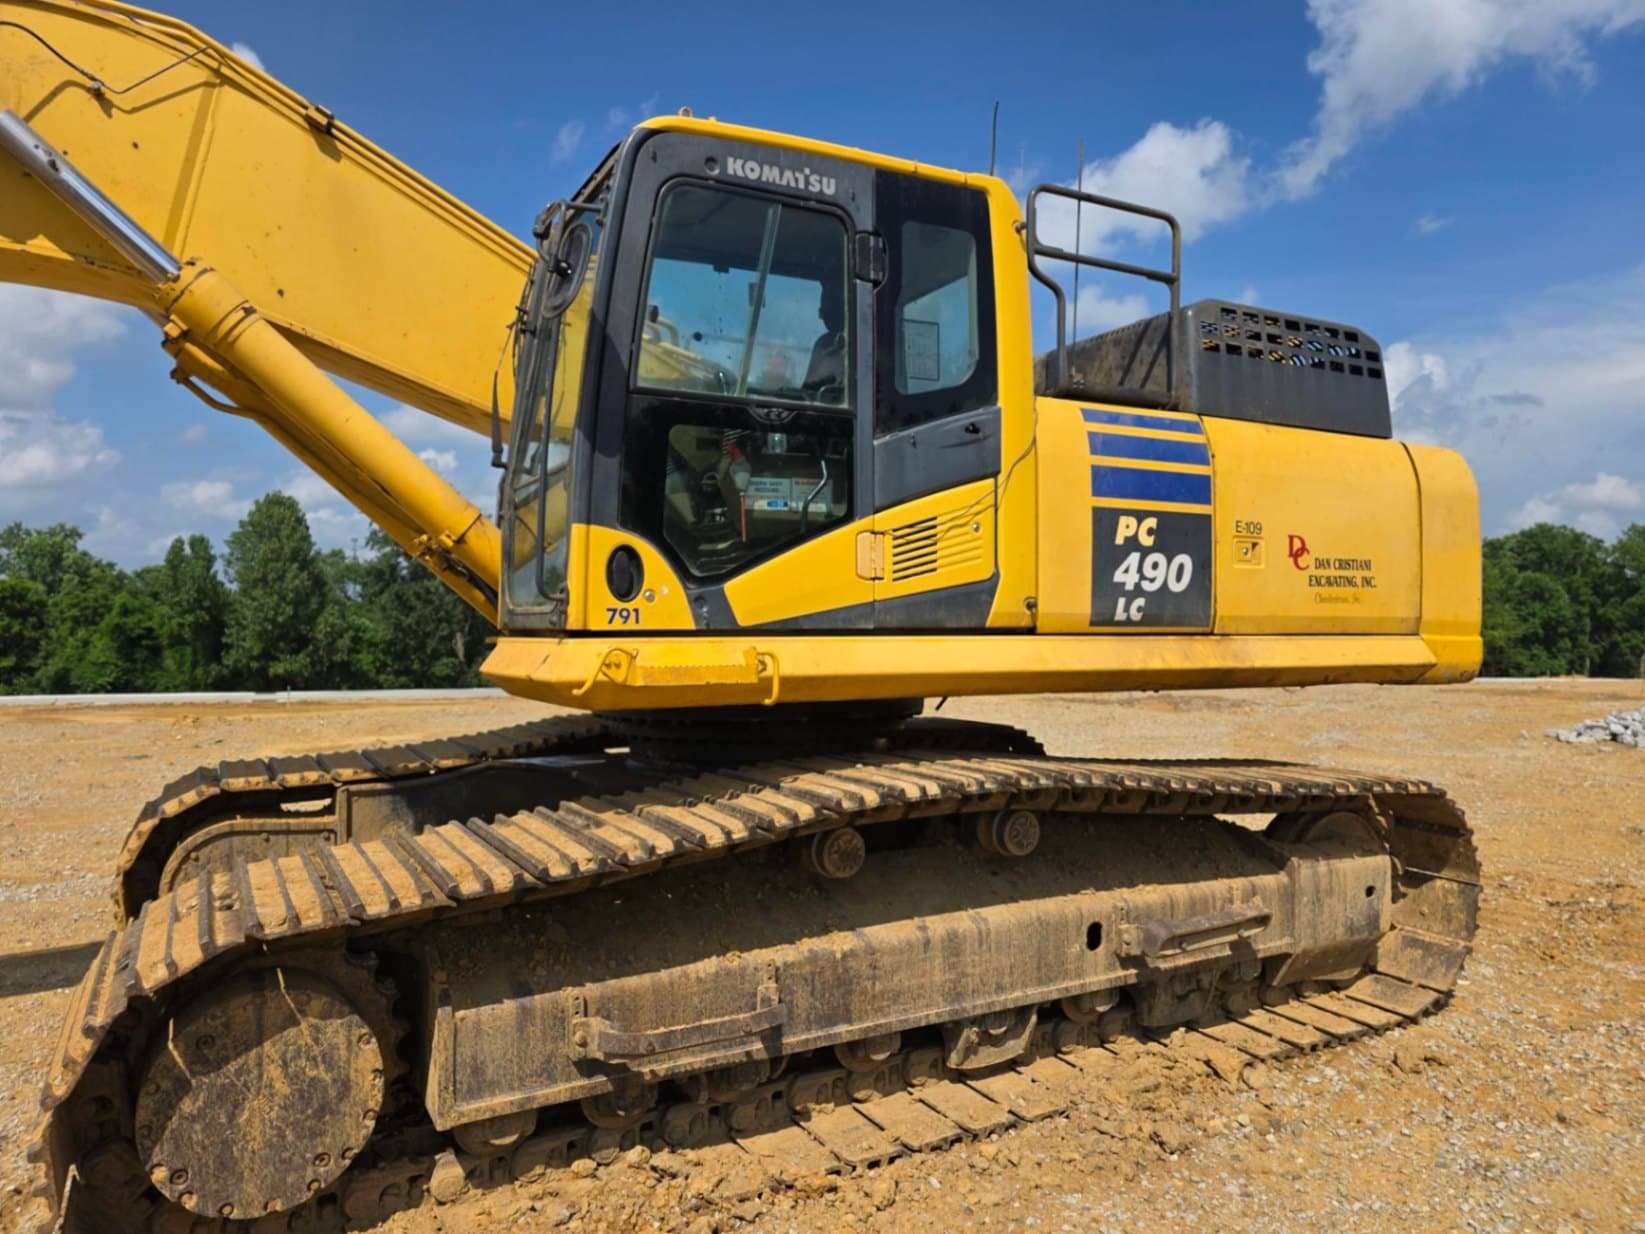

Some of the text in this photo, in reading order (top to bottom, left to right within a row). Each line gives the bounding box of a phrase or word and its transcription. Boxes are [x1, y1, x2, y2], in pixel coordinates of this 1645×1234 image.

[726, 156, 837, 196] KOMATSU
[1114, 515, 1158, 547] PC
[1235, 519, 1263, 536] E-109
[1112, 551, 1193, 593] 490
[1314, 557, 1372, 572] DAN CRISTIANI
[1308, 574, 1377, 589] EXCAVATING, INC.
[606, 607, 640, 625] 791
[1113, 596, 1147, 622] LC
